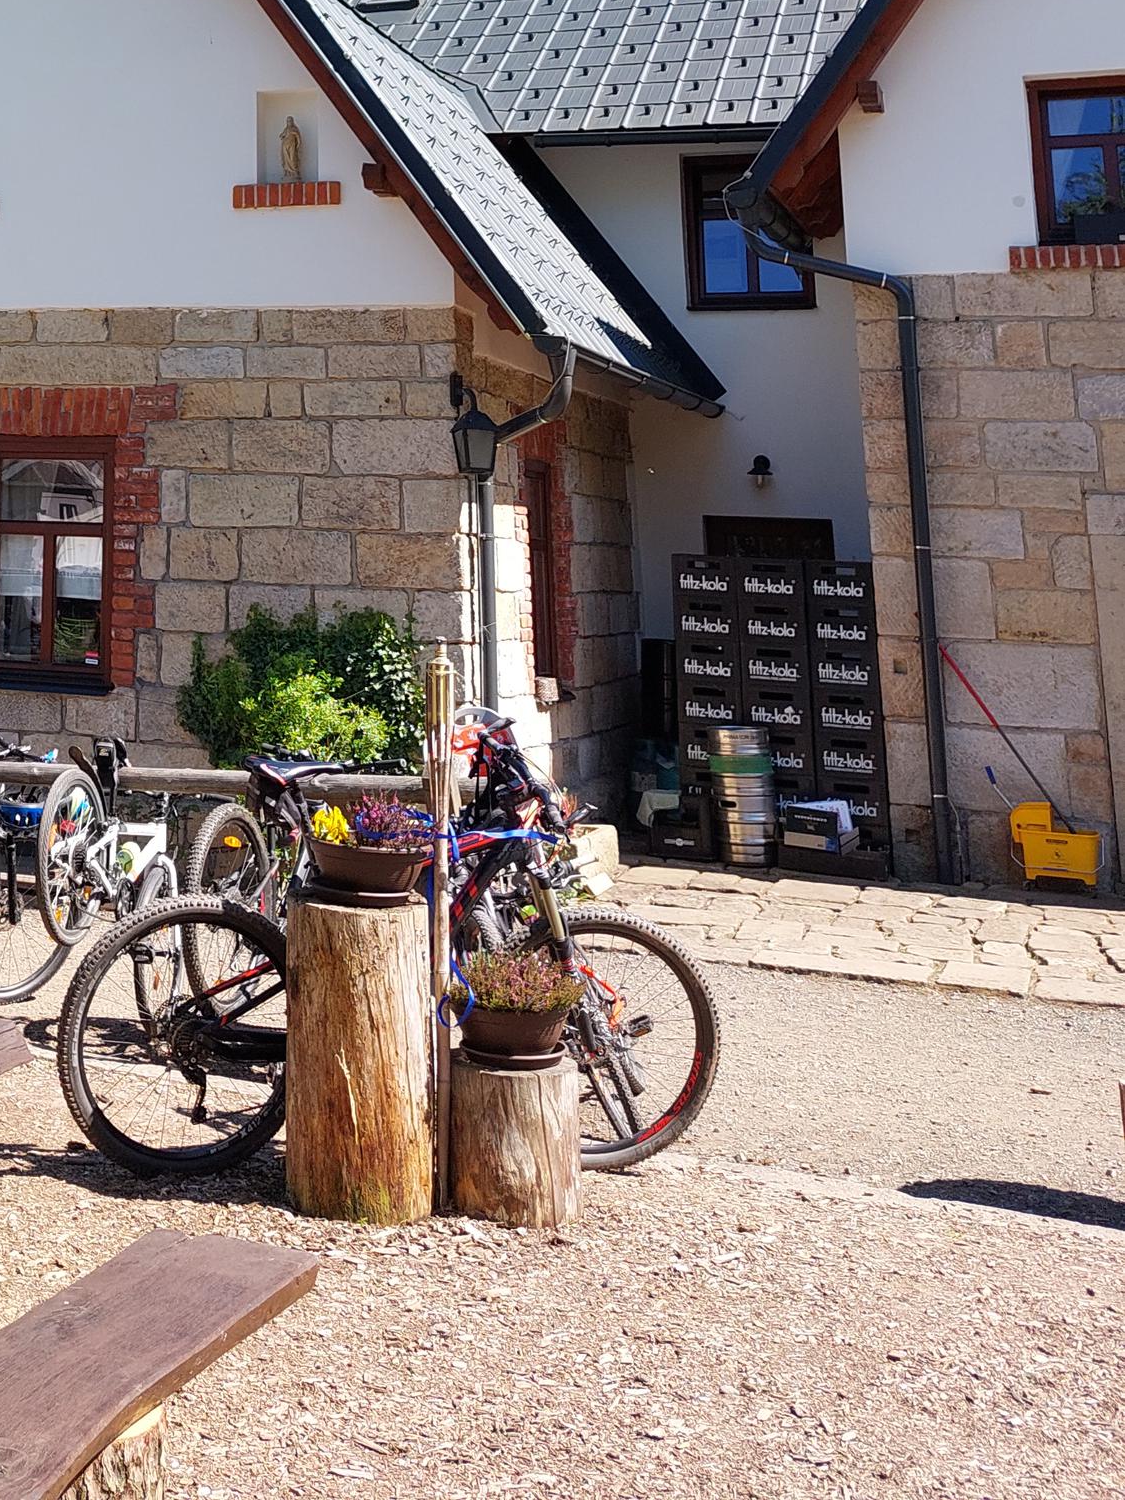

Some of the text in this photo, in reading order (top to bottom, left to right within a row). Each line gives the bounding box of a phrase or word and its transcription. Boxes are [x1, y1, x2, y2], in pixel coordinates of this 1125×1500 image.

[679, 573, 728, 592] fritz-kola
[744, 577, 794, 595] fritz-kola
[813, 580, 864, 597] fritz-kola
[681, 615, 730, 634] fritz-kola
[748, 620, 796, 637] fritz-kola
[816, 623, 867, 640] fritz-kola
[684, 658, 732, 677] fritz-kola
[748, 660, 797, 678] fritz-kola
[818, 662, 869, 680] fritz-kola
[685, 701, 733, 720] fritz-kola
[751, 706, 801, 725] fritz-kola
[821, 707, 872, 726] fritz-kola
[823, 750, 873, 769] fritz-kola
